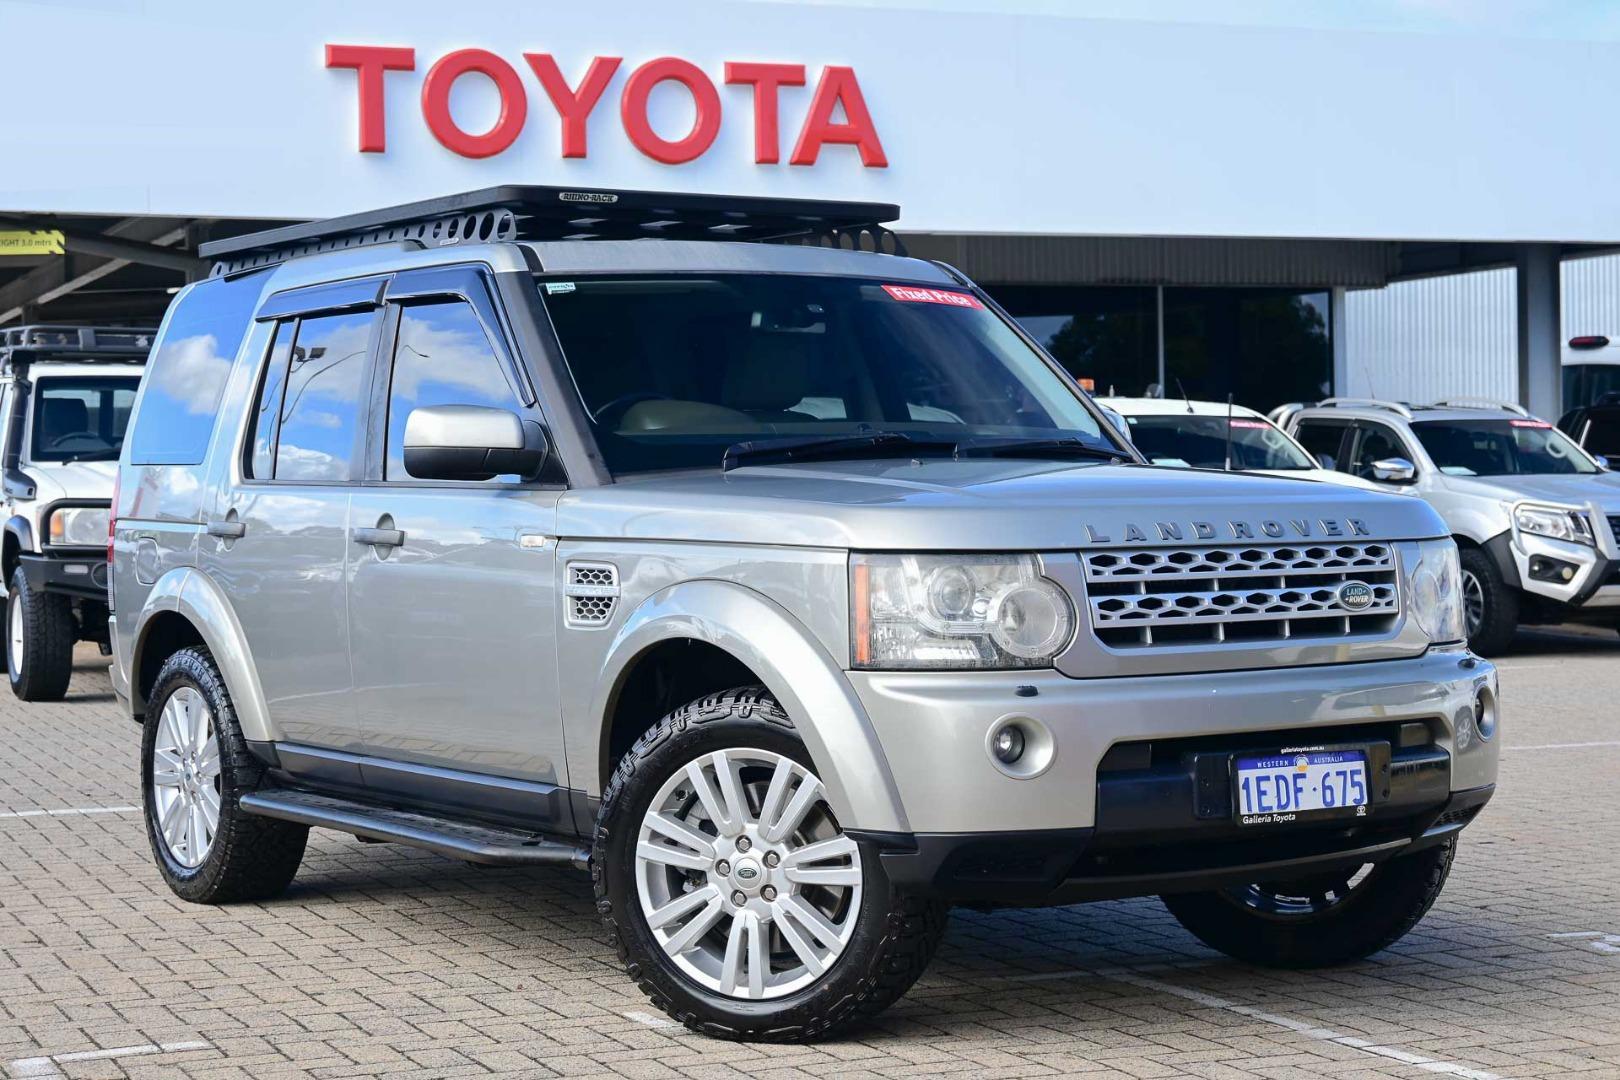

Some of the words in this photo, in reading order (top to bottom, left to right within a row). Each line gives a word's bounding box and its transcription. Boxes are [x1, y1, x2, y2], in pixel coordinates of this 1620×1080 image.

[325, 44, 889, 168] TOYOTA
[563, 192, 615, 202] RHINO-RACK
[890, 286, 936, 301] Fixed
[930, 290, 972, 306] Price
[1085, 520, 1217, 543] LAND
[1227, 517, 1371, 538] ROVER
[1346, 587, 1363, 596] LAND
[1348, 595, 1369, 603] ROVER
[1257, 760, 1289, 768] WESTERN
[1313, 756, 1344, 764] AUSTRALIA
[1242, 814, 1272, 824] Galleria
[1273, 812, 1296, 822] Toyota
